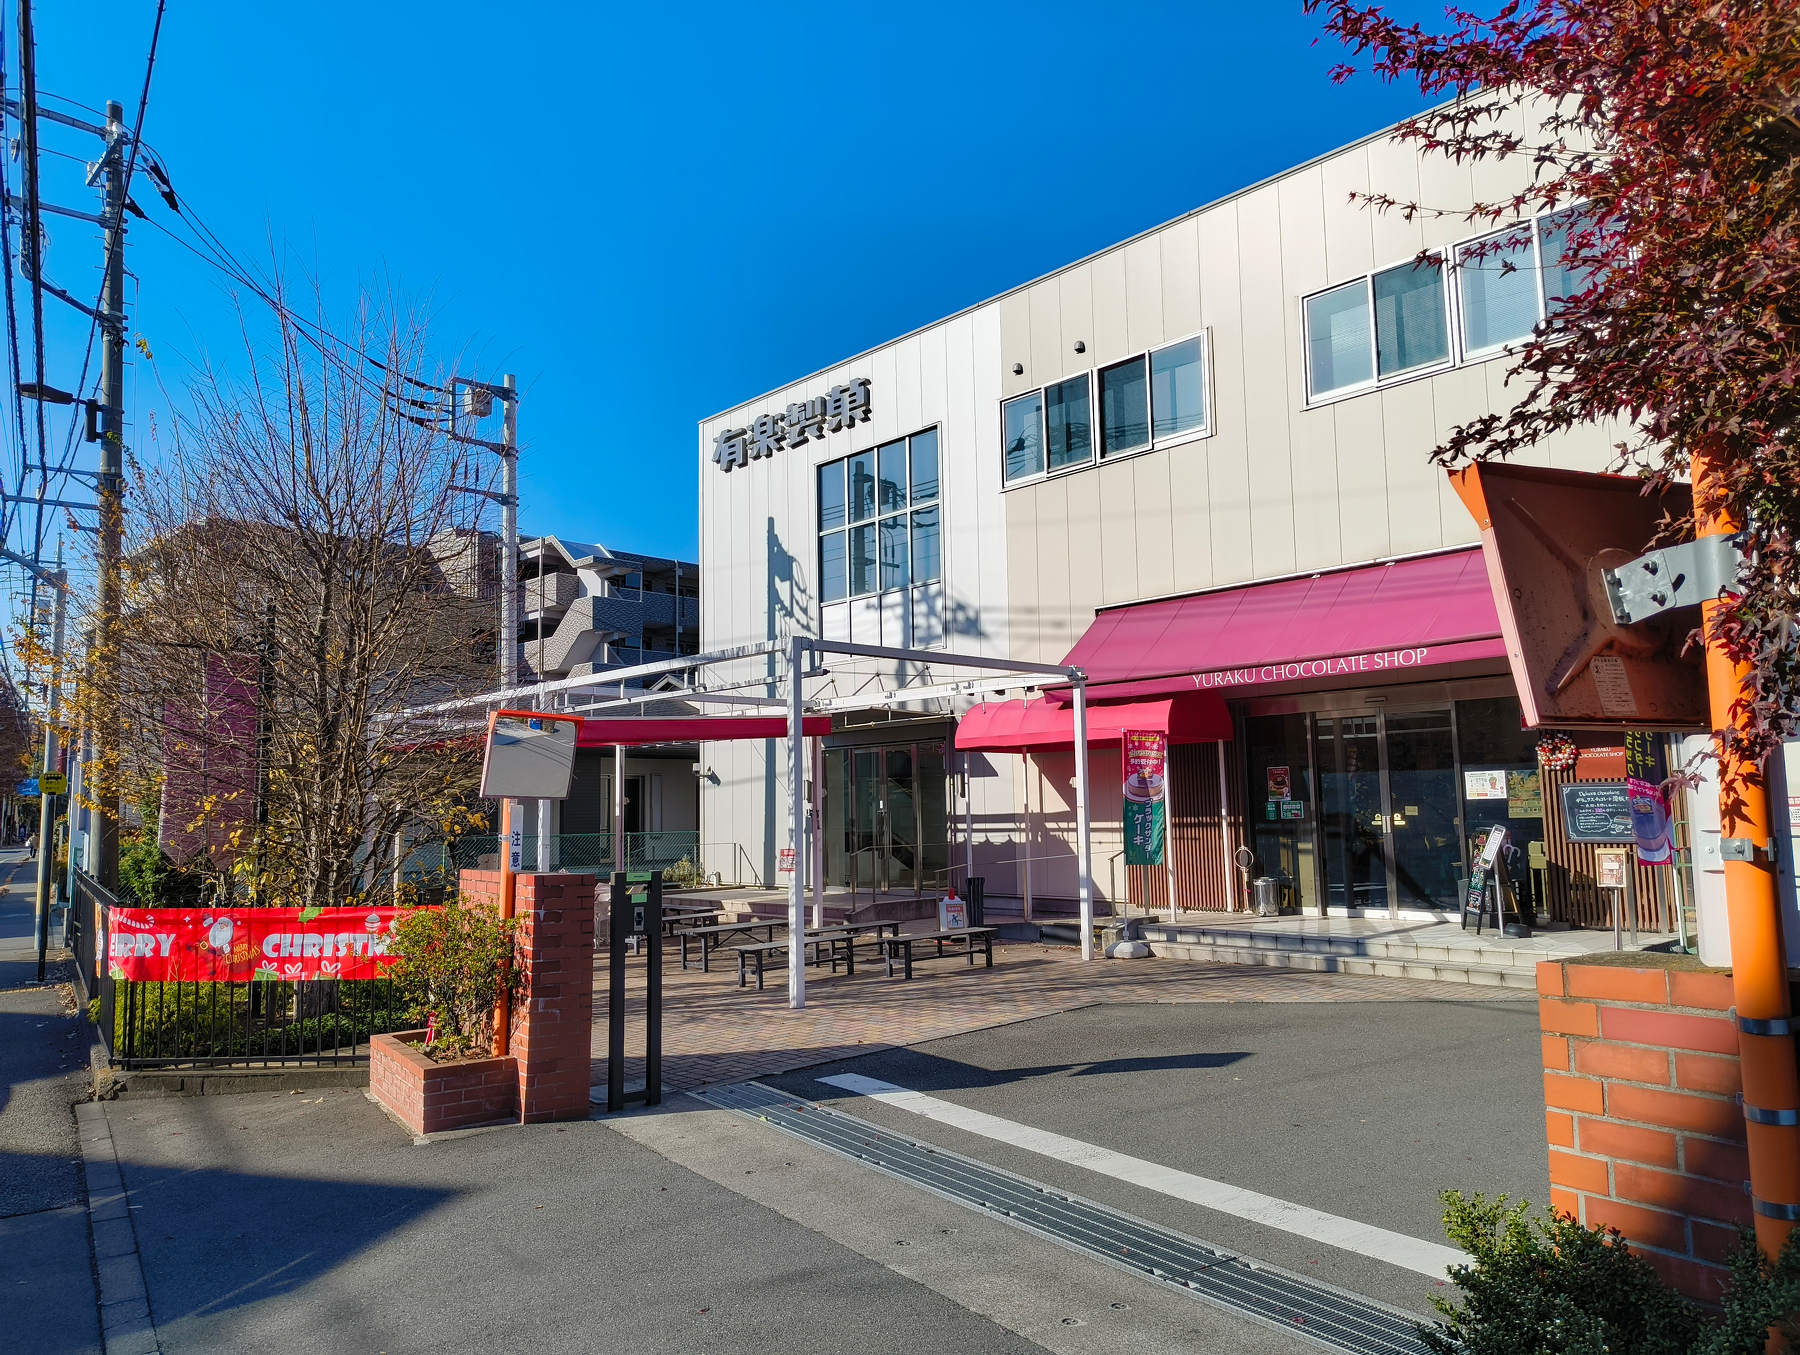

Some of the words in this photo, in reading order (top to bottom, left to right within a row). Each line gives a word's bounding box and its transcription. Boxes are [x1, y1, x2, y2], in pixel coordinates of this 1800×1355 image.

[712, 378, 872, 473] 有楽製菓
[1192, 669, 1256, 688] YURAKU
[1261, 655, 1368, 681] CHOCOLATE
[1374, 648, 1427, 669] SHOP
[1133, 813, 1144, 846] ケーキ
[1144, 798, 1153, 859] ブラックサンダー
[511, 831, 521, 868] 注意
[225, 944, 261, 964] CHRISTMAS
[262, 933, 400, 958] CHRISTM
